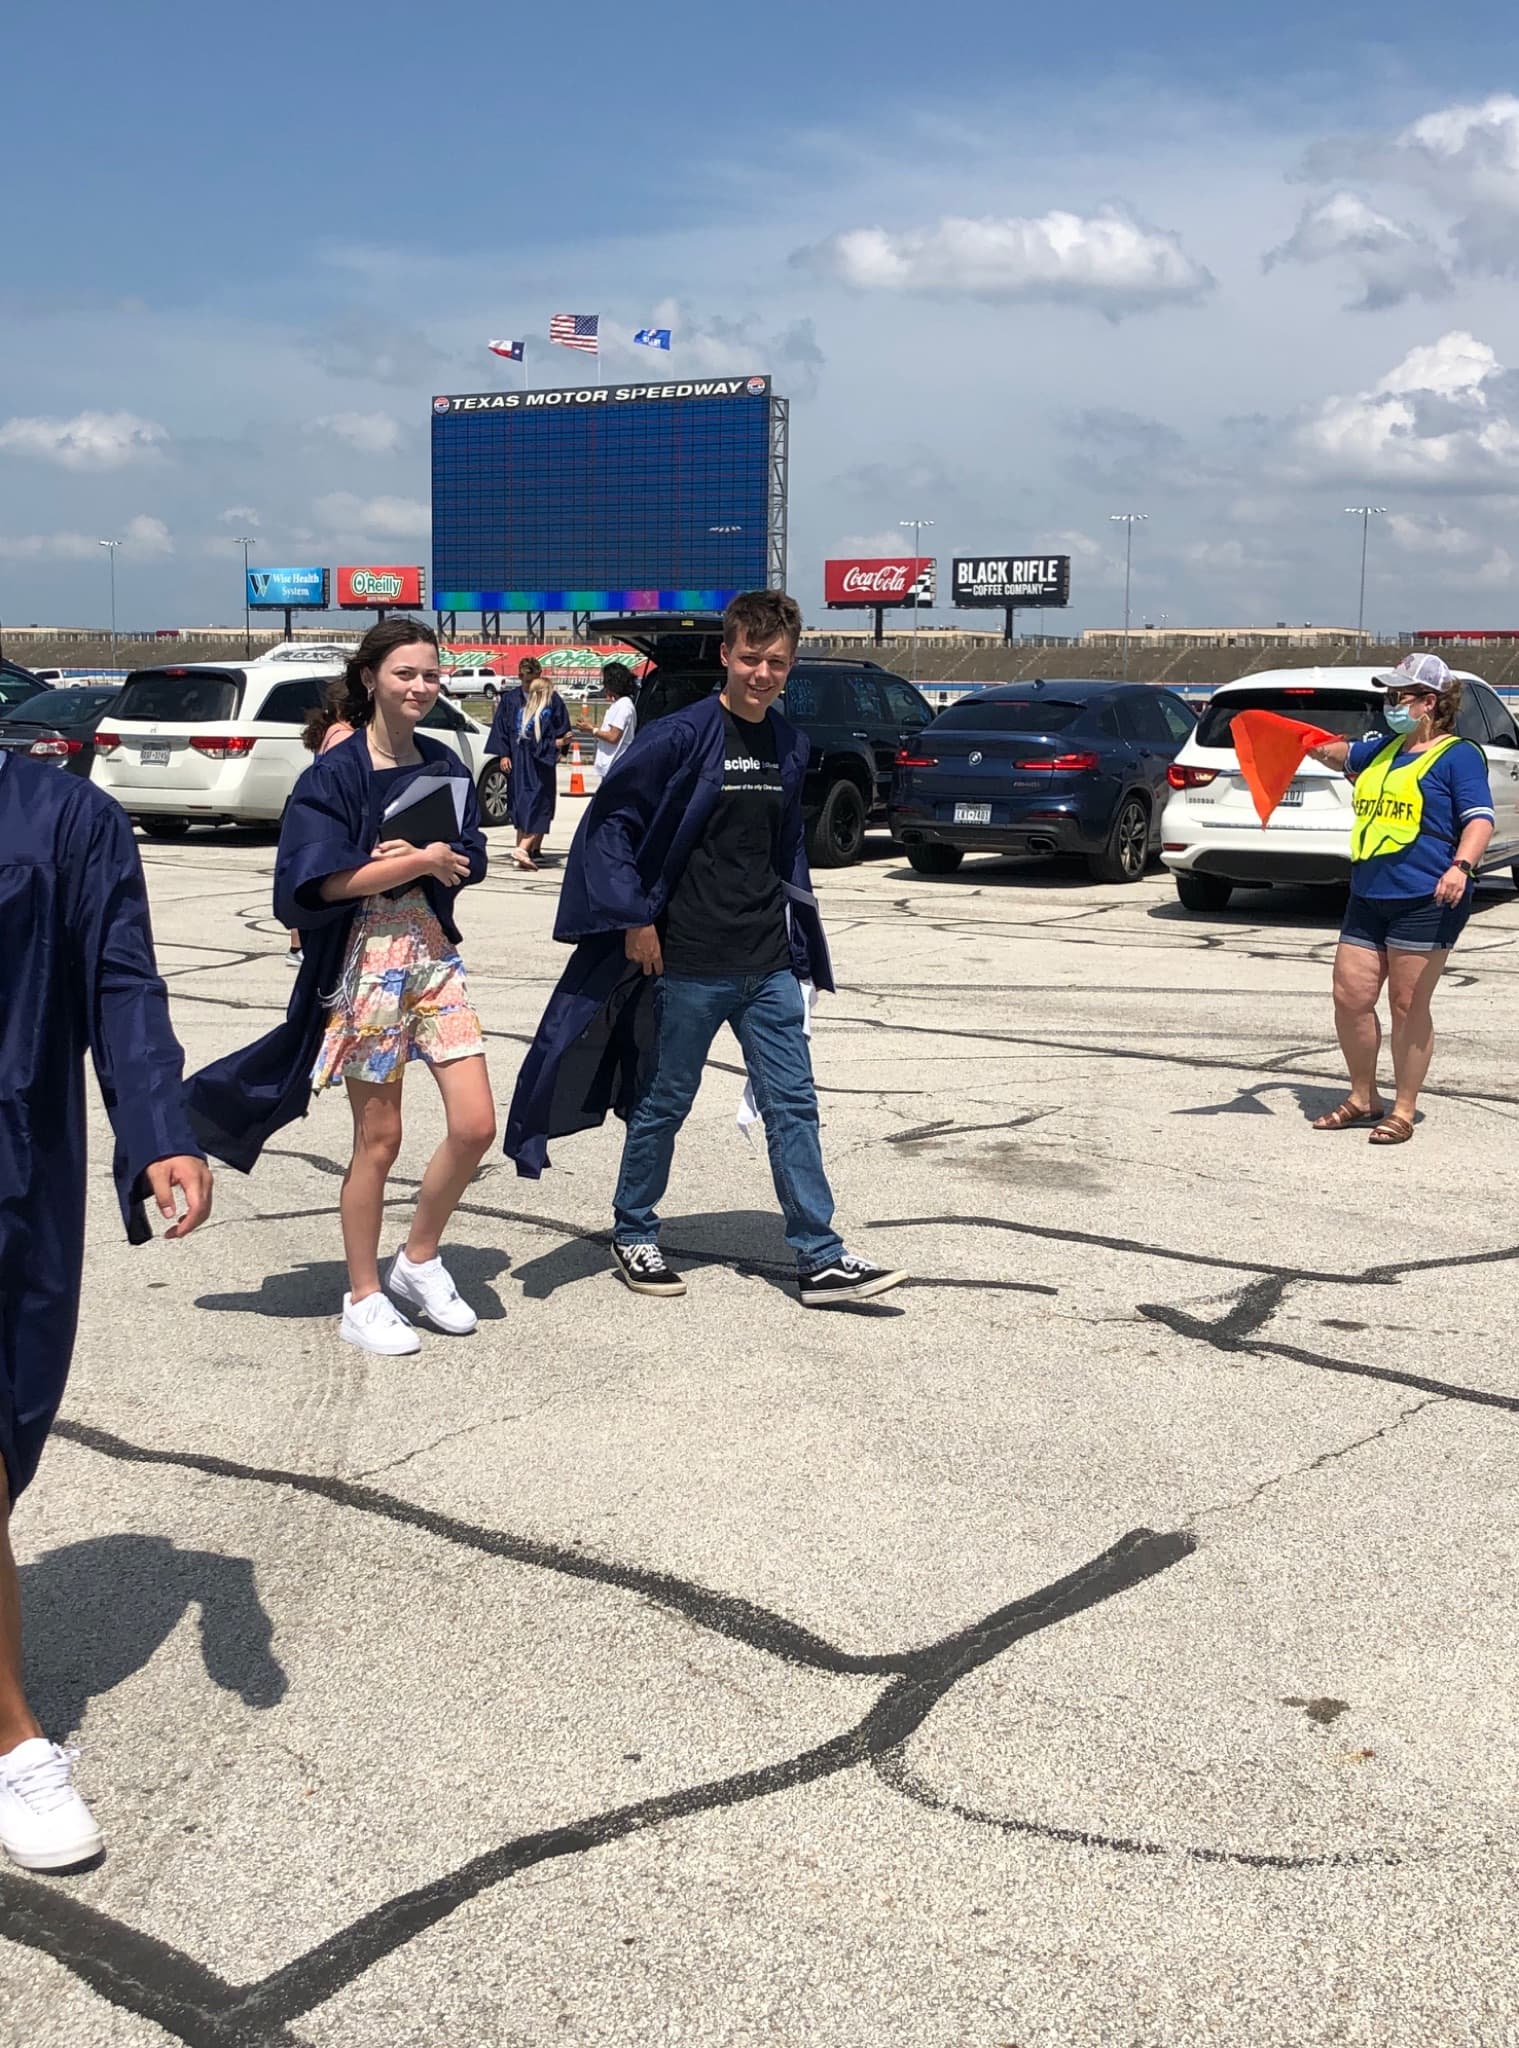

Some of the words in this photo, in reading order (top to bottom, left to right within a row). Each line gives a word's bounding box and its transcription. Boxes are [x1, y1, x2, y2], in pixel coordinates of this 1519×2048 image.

[453, 395, 520, 411] TEXAS
[526, 390, 608, 405] MOTOR
[615, 381, 744, 401] SPEEDWAY
[272, 573, 291, 583] Wise
[293, 573, 319, 583] Health
[353, 570, 402, 596] O'Reilly
[842, 565, 909, 592] Coca-Cola
[957, 560, 1008, 584] BLACK
[1012, 560, 1058, 583] RIFLE
[282, 586, 309, 598] System
[972, 584, 1003, 596] COFFEE
[1004, 583, 1044, 596] COMPANY
